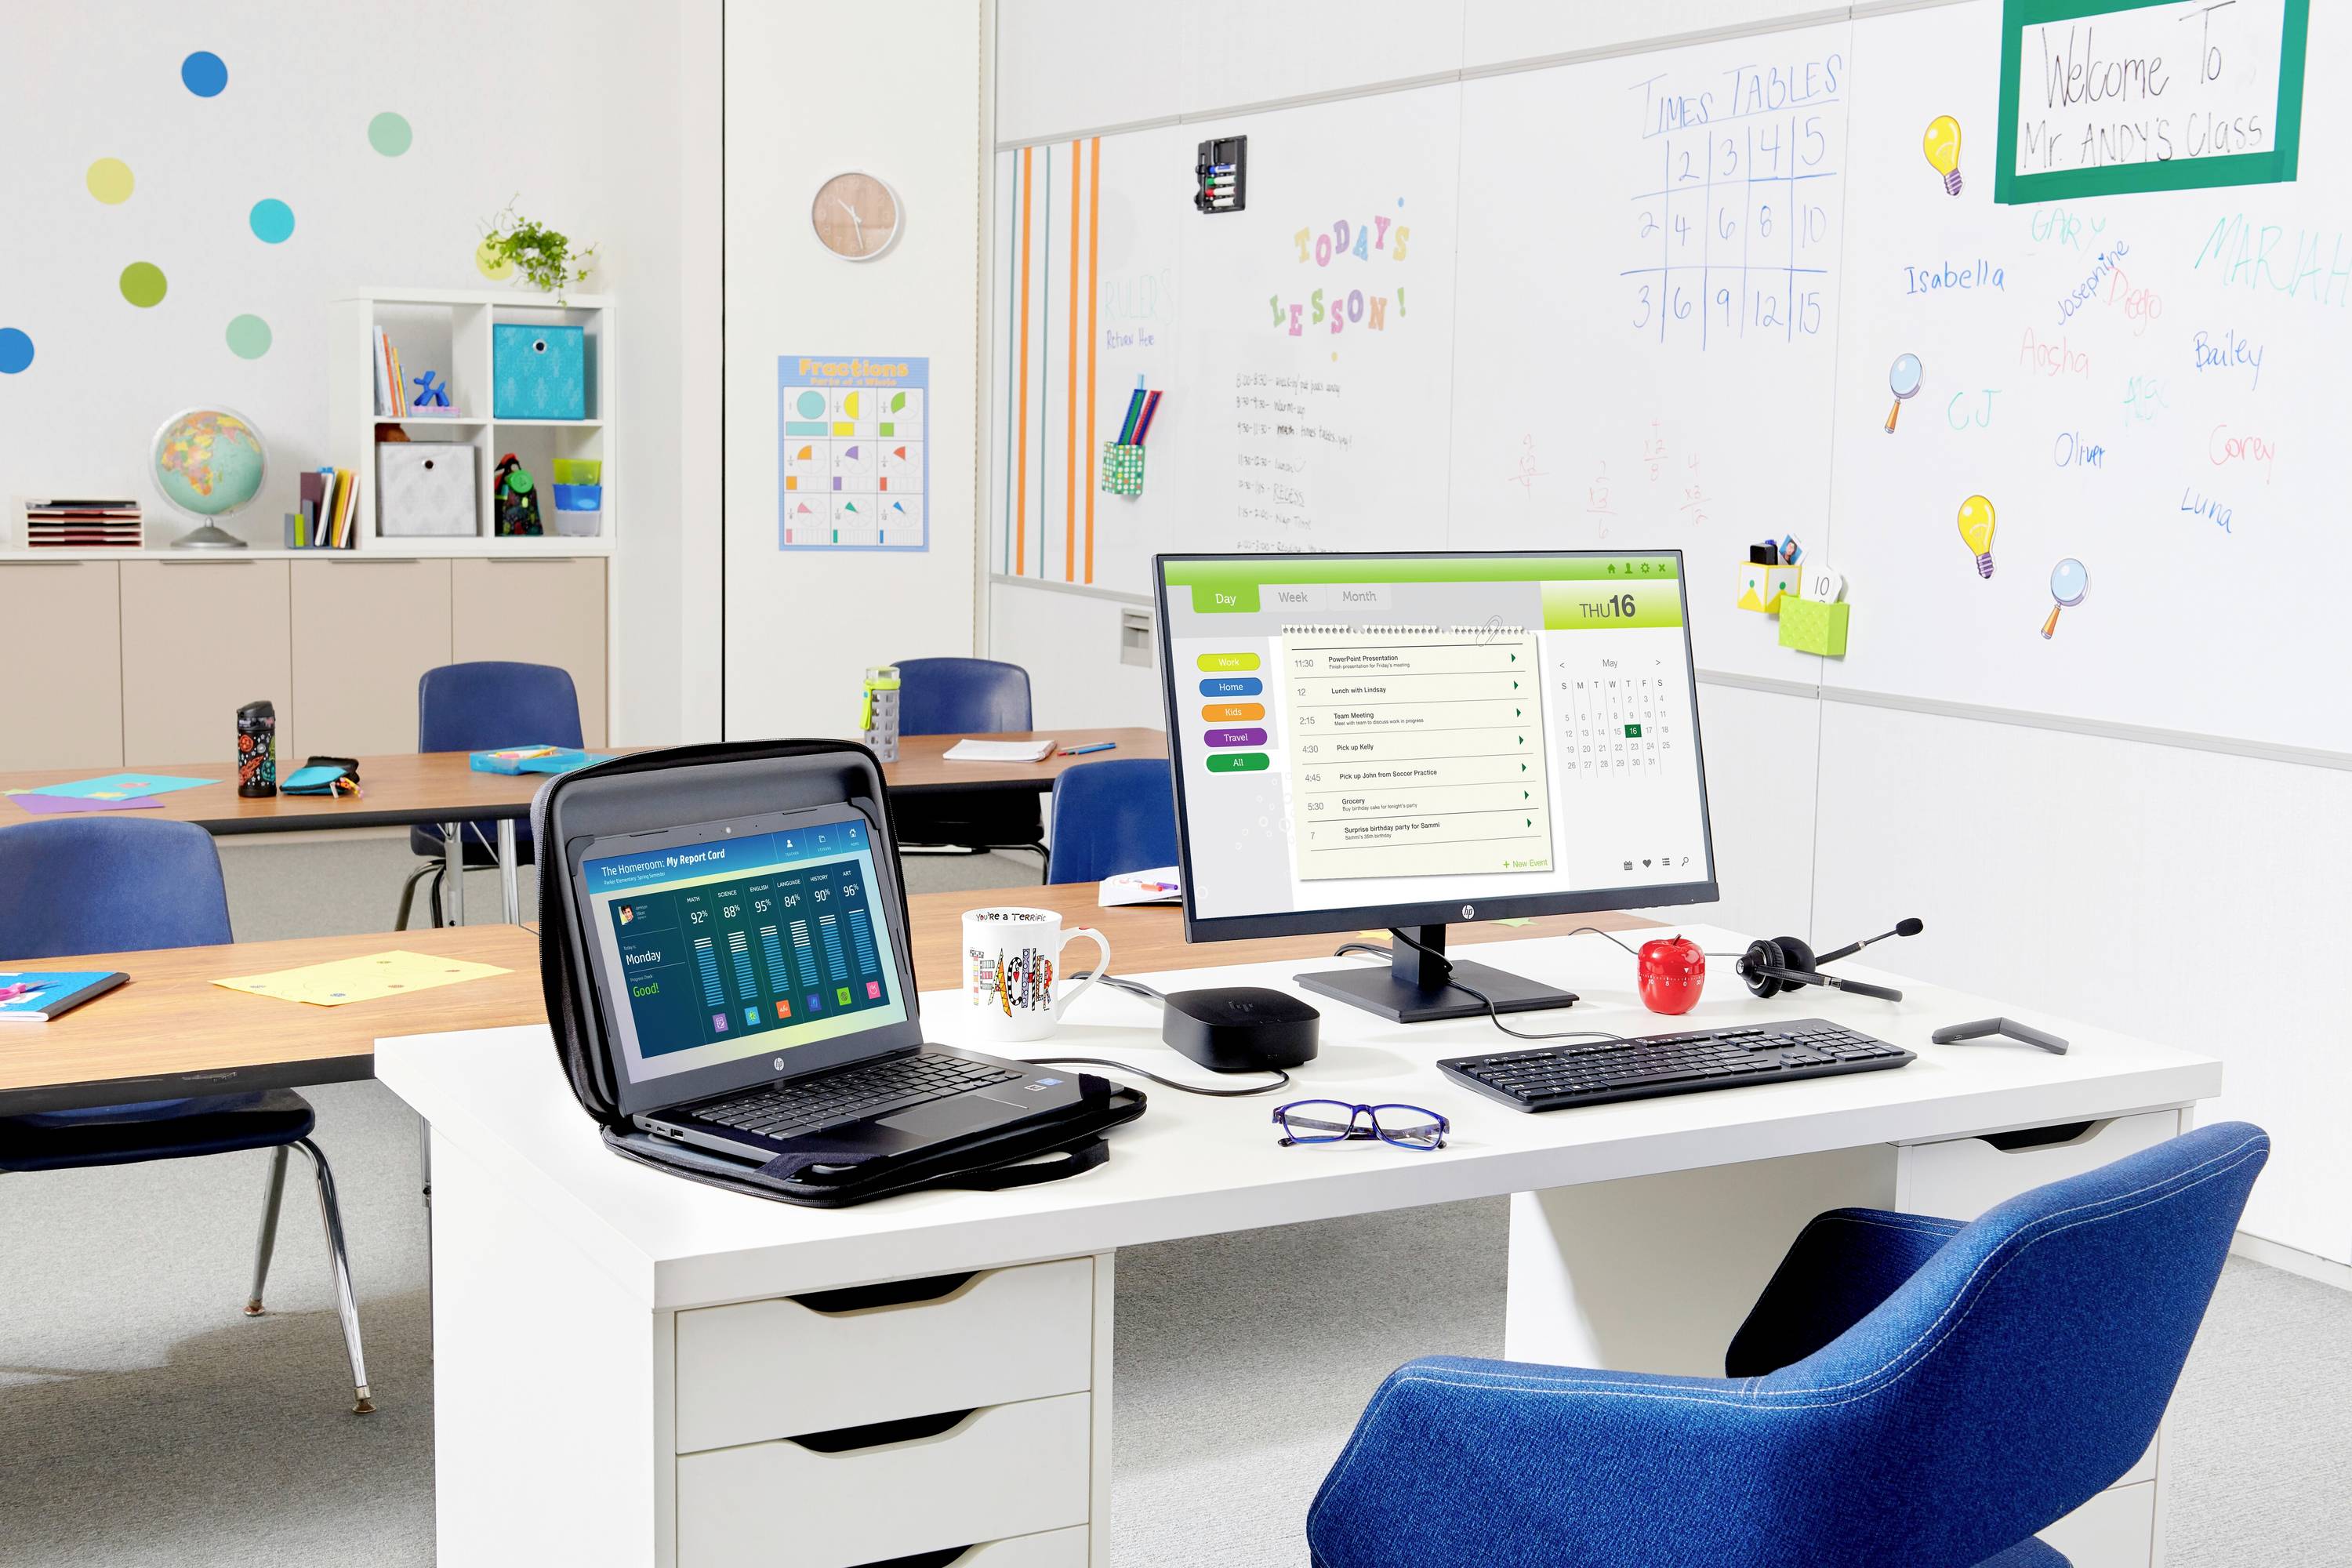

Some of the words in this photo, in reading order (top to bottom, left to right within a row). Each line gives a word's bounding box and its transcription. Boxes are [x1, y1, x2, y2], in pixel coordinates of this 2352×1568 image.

[2041, 25, 2169, 108] Welcome
[2179, 1, 2237, 84] To
[1628, 74, 1713, 138] TIMES
[1722, 54, 1842, 115] TABLES
[1679, 151, 1700, 181] 2
[1720, 139, 1737, 176] 3
[1761, 124, 1781, 171] 4
[1802, 117, 1824, 165] 5
[2023, 119, 2063, 169] Mr.
[2081, 117, 2173, 166] ANDY'S
[2188, 112, 2263, 158] Class
[1639, 212, 1660, 238] 2
[1675, 214, 1691, 246] 4
[1719, 207, 1736, 240] 6
[1760, 205, 1772, 237] 8
[1802, 204, 1826, 249] 10
[1904, 259, 2005, 295] Isabella
[2194, 213, 2352, 308] MARIAH
[1104, 269, 1174, 325] RULERS
[2057, 240, 2129, 325] Josephine
[1269, 287, 1406, 337] LESSON!
[1633, 285, 1650, 328] 3
[1675, 287, 1691, 319] 6
[1717, 289, 1730, 326] 9
[1755, 291, 1784, 327] 12
[1799, 292, 1820, 334] 15
[800, 358, 908, 376] Fractions
[2193, 329, 2263, 391] Bailey
[1947, 390, 2002, 430] CJ
[2054, 432, 2105, 468] Oliver
[2209, 424, 2275, 485] Corey
[2181, 487, 2233, 534] Luna
[1216, 593, 1236, 606] Day
[1278, 591, 1308, 602] Week
[1343, 590, 1377, 601] Month
[1815, 576, 1830, 596] 10
[1218, 657, 1240, 666] Work
[1602, 659, 1617, 668] May
[1224, 733, 1248, 742] Travel
[1300, 717, 1315, 725] 2:15
[1302, 745, 1319, 753] 4:30
[1305, 773, 1321, 782] 4:45
[1308, 802, 1324, 811] 5:30
[601, 865, 617, 877] The
[618, 859, 665, 875] Homeroom:
[666, 856, 678, 868] My
[680, 852, 706, 865] Report
[707, 848, 725, 860] Card
[637, 873, 649, 882] Spring
[691, 909, 708, 924] 92%
[723, 904, 741, 918] 88%
[754, 898, 771, 913] 95%
[784, 894, 800, 907] 84%
[814, 888, 831, 902] 90%
[843, 884, 859, 897] 96%
[717, 889, 738, 898] SCIENCE
[777, 879, 801, 887] LANGUAGE
[1462, 904, 1475, 920] hp
[626, 950, 661, 965] Monday
[633, 982, 659, 997] Good!
[970, 948, 1053, 1017] TEACHER
[774, 1058, 785, 1071] hp
